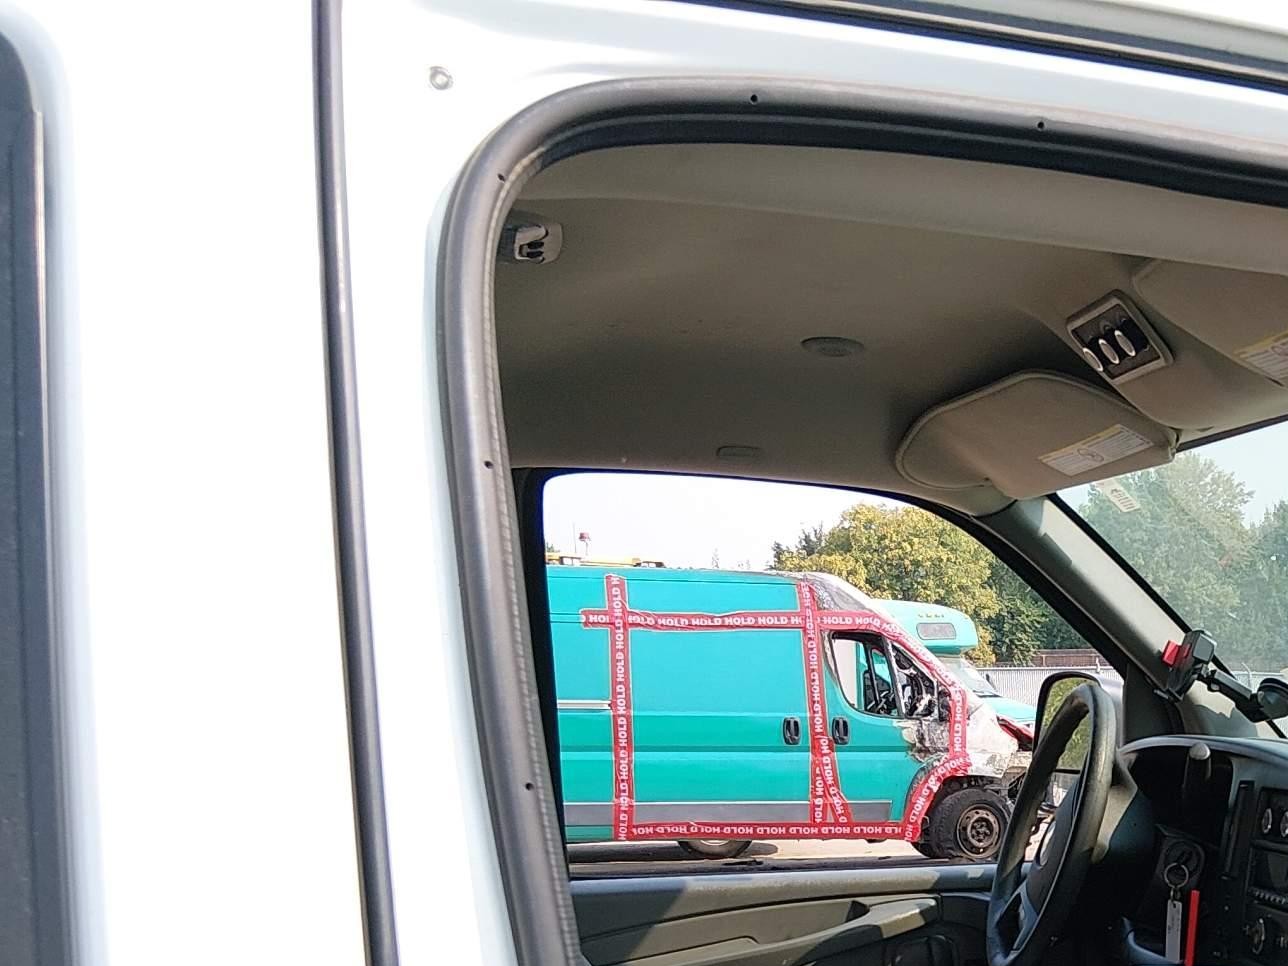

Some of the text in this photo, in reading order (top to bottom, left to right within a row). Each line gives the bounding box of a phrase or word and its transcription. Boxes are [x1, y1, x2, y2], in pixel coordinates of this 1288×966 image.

[611, 587, 623, 617] HOLD
[614, 619, 624, 649] HOLD
[657, 617, 689, 626] HOLD
[691, 617, 722, 626] HOLD
[724, 617, 756, 625] HOLD
[758, 616, 788, 625] HOLD
[823, 616, 852, 625] HOLD
[615, 652, 625, 682] HOLD
[807, 641, 818, 669] HOLD
[616, 684, 627, 714] HOLD
[810, 672, 820, 701] HOLD
[618, 716, 628, 747] HOLD
[813, 703, 824, 732] HOLD
[953, 723, 962, 752] HOLD
[619, 749, 629, 779] HOLD
[822, 755, 834, 785] HOLD
[618, 813, 629, 841] HOLD
[656, 824, 687, 835] HOLD
[723, 825, 754, 835] HOLD
[757, 826, 786, 835] HOLD
[788, 826, 818, 835] HOLD
[821, 826, 850, 835] HOLD
[853, 826, 882, 835] HOLD
